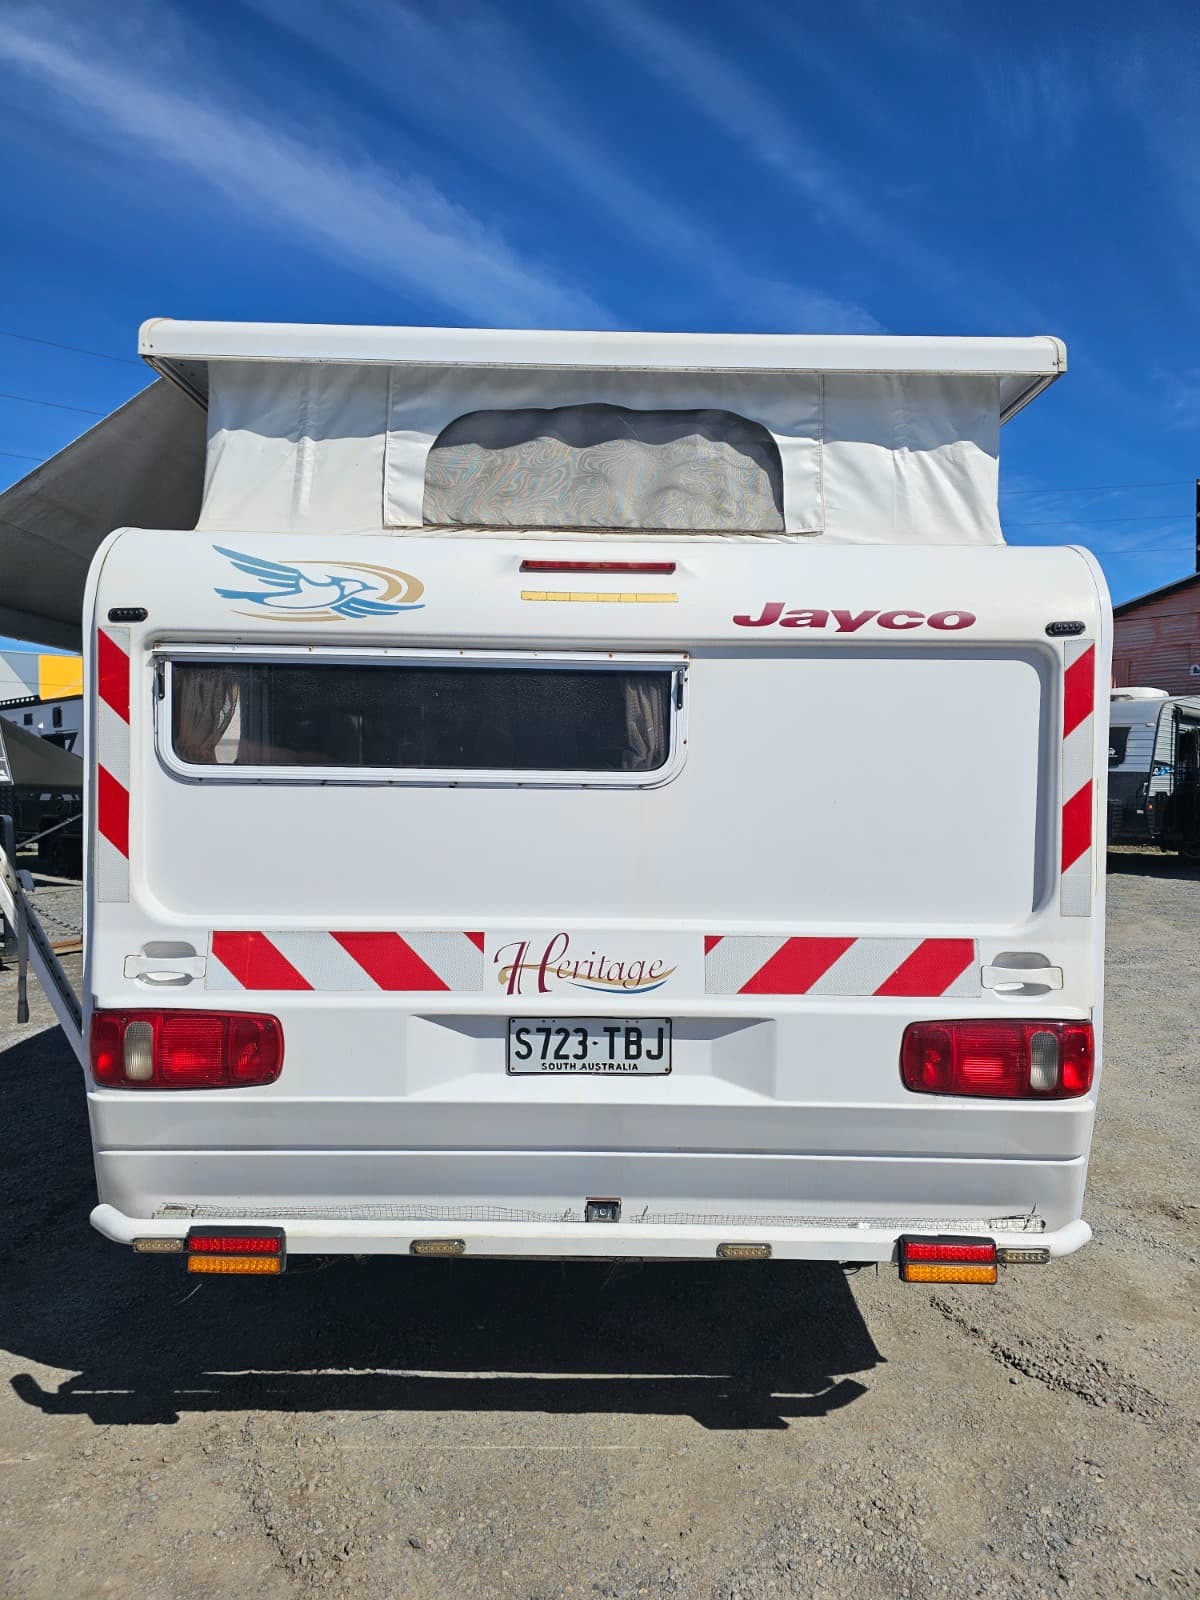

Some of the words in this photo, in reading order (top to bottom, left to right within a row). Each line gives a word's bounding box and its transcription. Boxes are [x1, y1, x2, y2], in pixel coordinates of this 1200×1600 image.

[732, 601, 977, 633] Jayco
[493, 932, 664, 996] Heritage
[541, 1062, 576, 1071] SOUTH
[580, 1062, 639, 1072] AUSTRALIA
